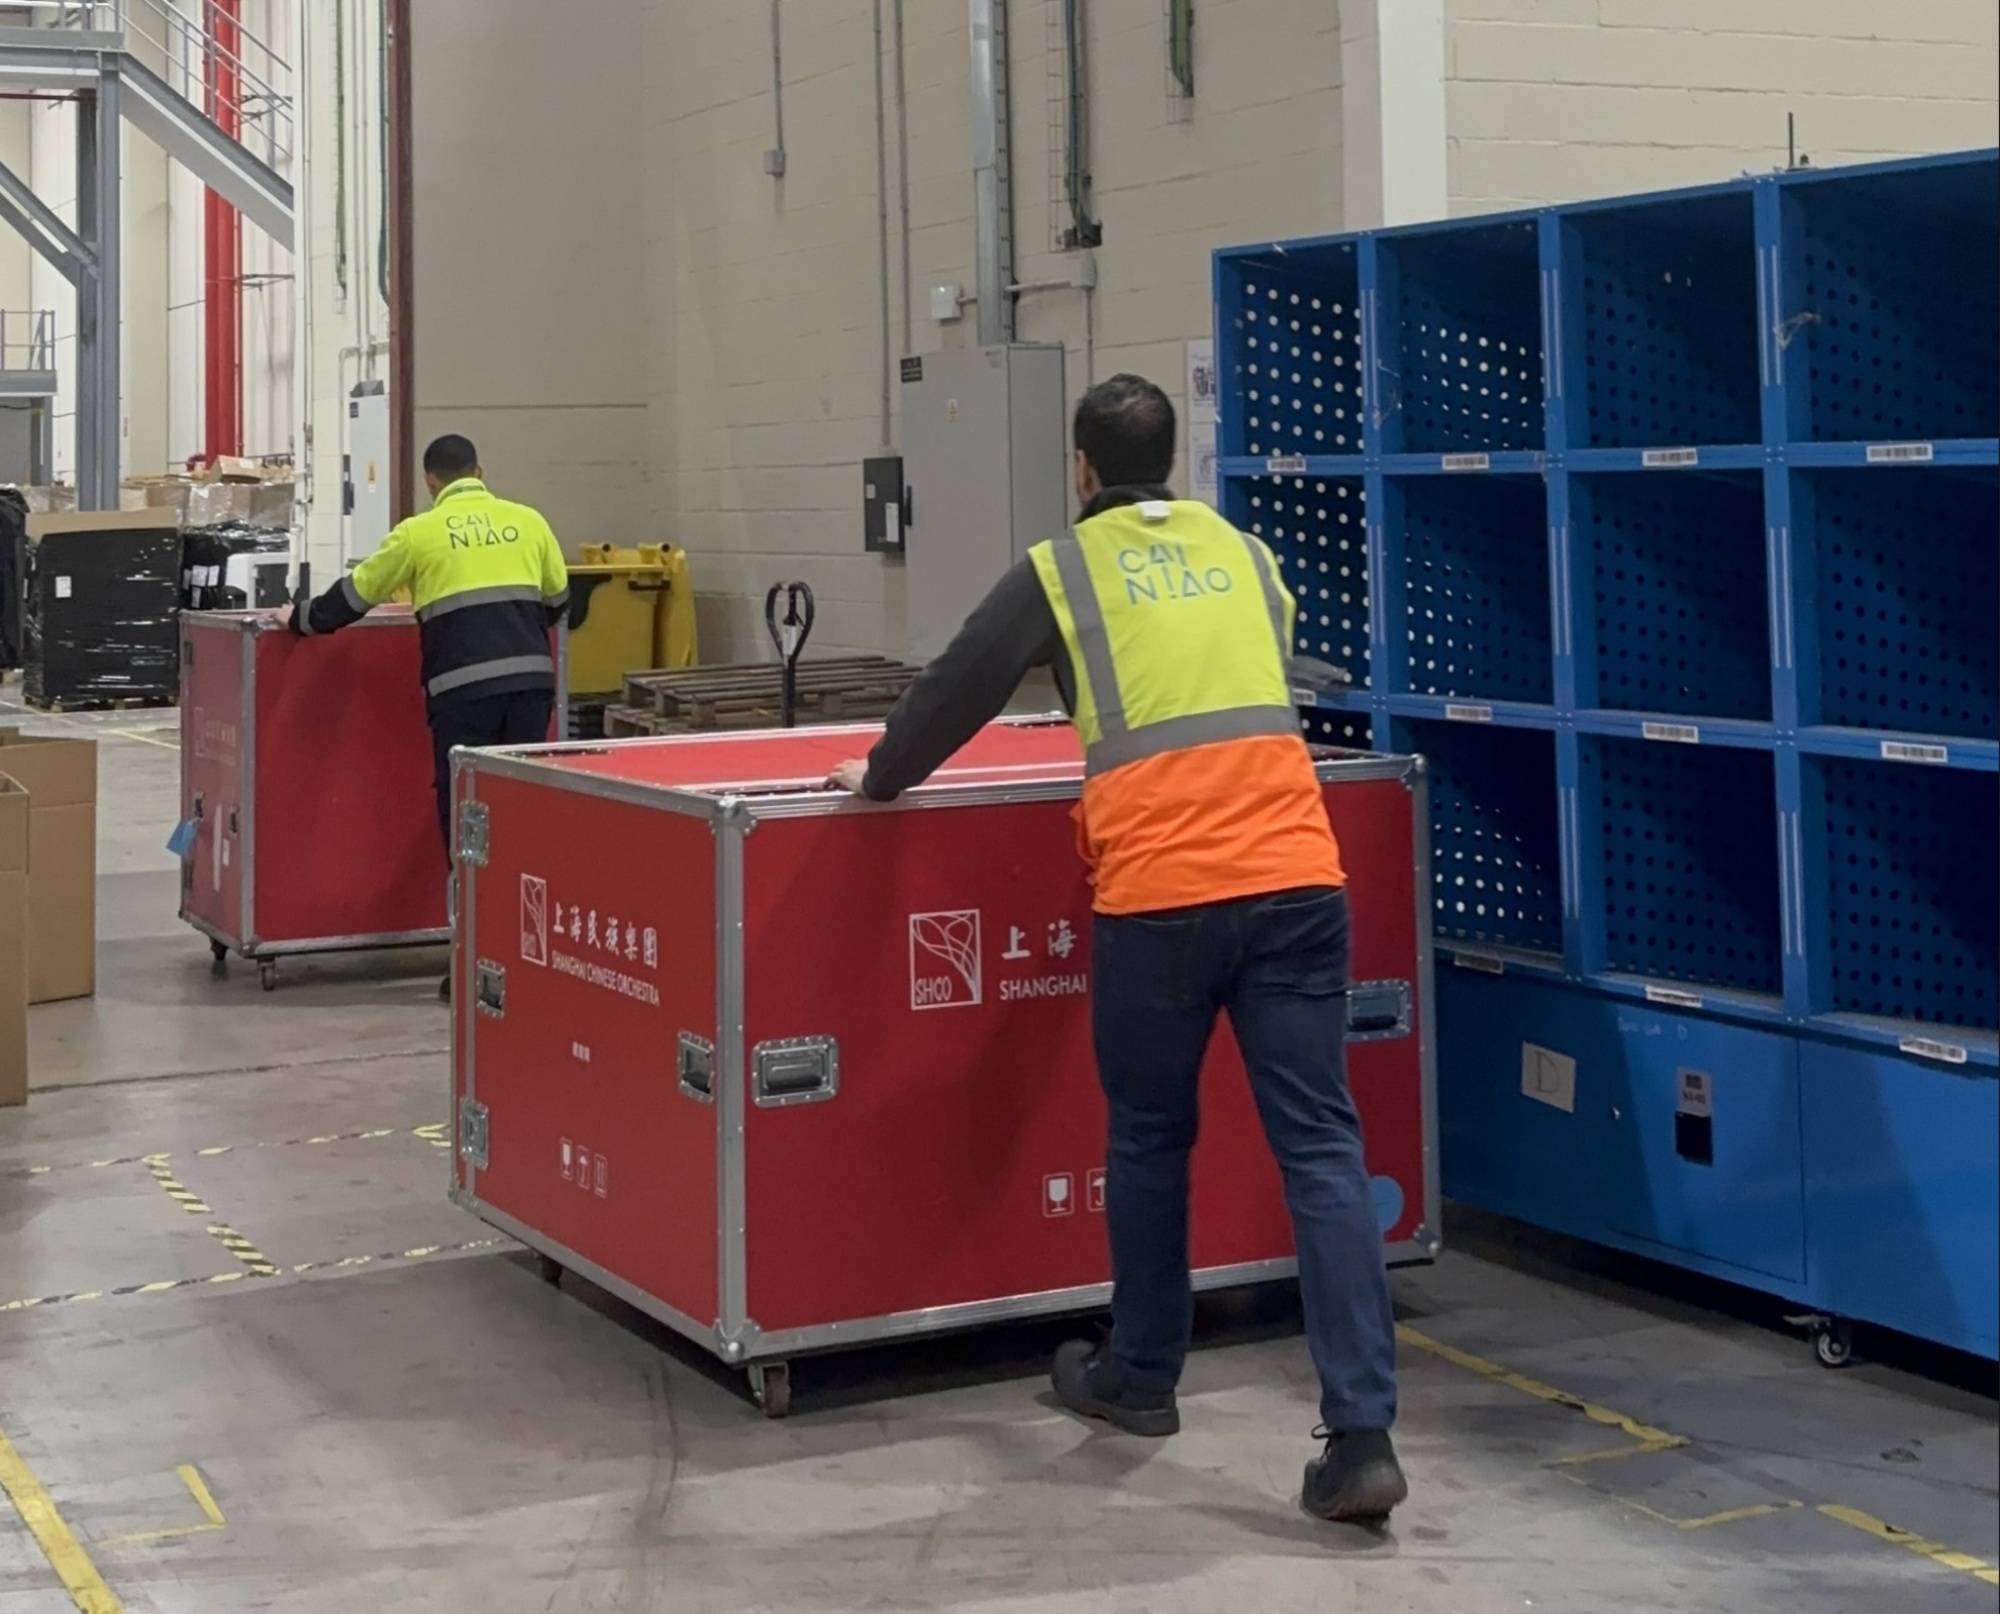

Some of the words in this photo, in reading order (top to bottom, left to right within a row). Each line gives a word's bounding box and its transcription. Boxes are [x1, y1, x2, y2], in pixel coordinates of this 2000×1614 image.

[446, 512, 491, 530] CAI
[1118, 543, 1187, 573] CAI
[1001, 919, 1078, 960] 上海
[915, 976, 952, 1004] SHCO
[1000, 974, 1087, 1000] SHANGHAI
[1534, 1051, 1560, 1094] D
